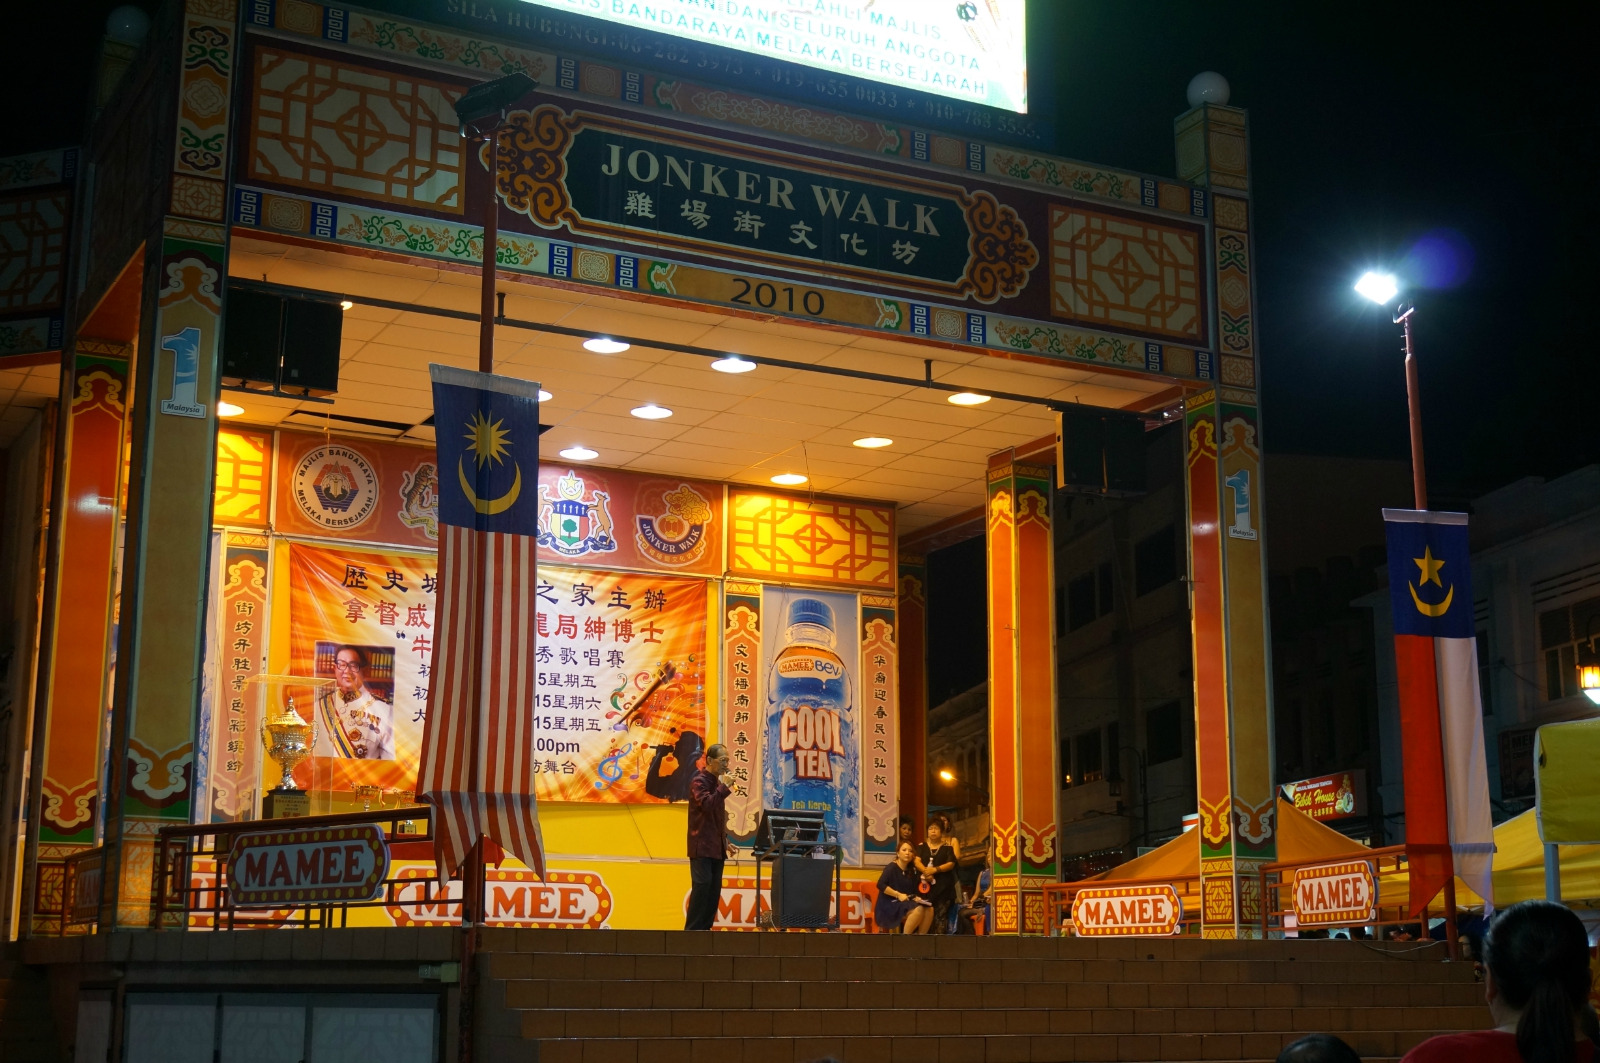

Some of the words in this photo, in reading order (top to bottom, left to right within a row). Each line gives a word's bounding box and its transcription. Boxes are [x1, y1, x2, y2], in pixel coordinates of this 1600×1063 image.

[612, 0, 747, 41] BANDARAYA
[757, 31, 843, 63] MELAKA
[852, 53, 986, 95] BERSEJARAH
[779, 13, 876, 47] SELURUH
[885, 38, 980, 71] ANGGOTA
[601, 143, 797, 211] JONKER
[811, 184, 941, 238] WALK
[624, 189, 920, 266] 雞場街文化坊
[730, 278, 826, 316] 2010
[166, 403, 201, 414] Malaysia
[298, 451, 325, 478] MAJLIS
[328, 449, 374, 486] BANDARAYA
[297, 489, 322, 521] MELAKA
[325, 496, 374, 527] BERSEJARAH
[642, 523, 676, 553] JONKER
[678, 528, 700, 551] WALK
[1232, 529, 1254, 537] Malaysia
[342, 597, 432, 630] 拿督威
[781, 661, 810, 670] MAMEE
[779, 705, 846, 759] COOL
[794, 750, 833, 781] TEA
[243, 844, 366, 888] MAMEE
[1300, 876, 1364, 912] MAMEE
[1085, 900, 1168, 926] MAMEE
